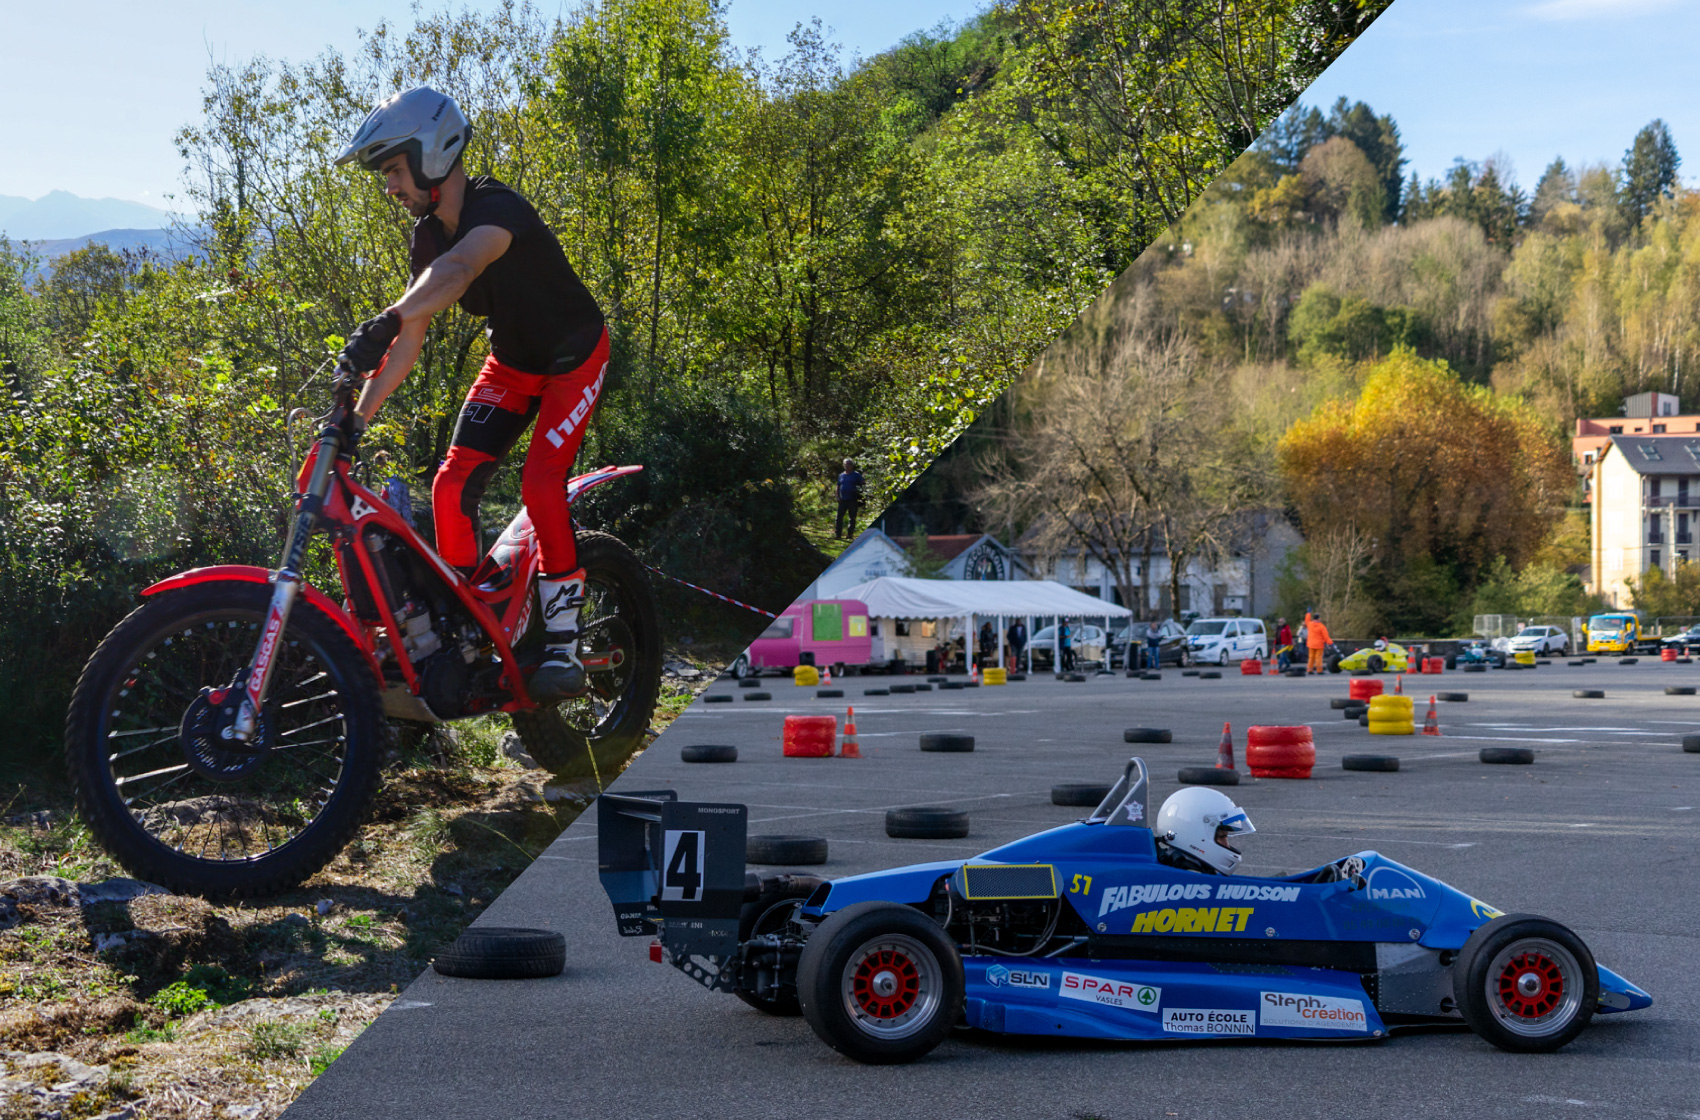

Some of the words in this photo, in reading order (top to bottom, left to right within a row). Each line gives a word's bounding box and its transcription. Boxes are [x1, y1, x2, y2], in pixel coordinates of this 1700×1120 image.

[250, 618, 281, 692] GASGAS
[697, 807, 740, 815] MONOSPORT
[666, 832, 701, 899] 4
[1098, 884, 1212, 917] FABULOUS
[1215, 887, 1301, 902] HUDSON
[1371, 888, 1421, 899] MAN
[1130, 907, 1254, 933] HORNET
[1010, 972, 1048, 986] SLN
[1064, 975, 1134, 998] SPAR
[1095, 995, 1123, 1006] VASLES
[1264, 993, 1321, 1013] Steph
[1171, 1012, 1205, 1022] AUTO
[1208, 1011, 1248, 1023] ÉCOLE
[1302, 1004, 1365, 1021] création
[1164, 1022, 1204, 1033] Thomas
[1206, 1023, 1254, 1034] BONNIN
[1263, 1018, 1306, 1026] SOLUTIONS
